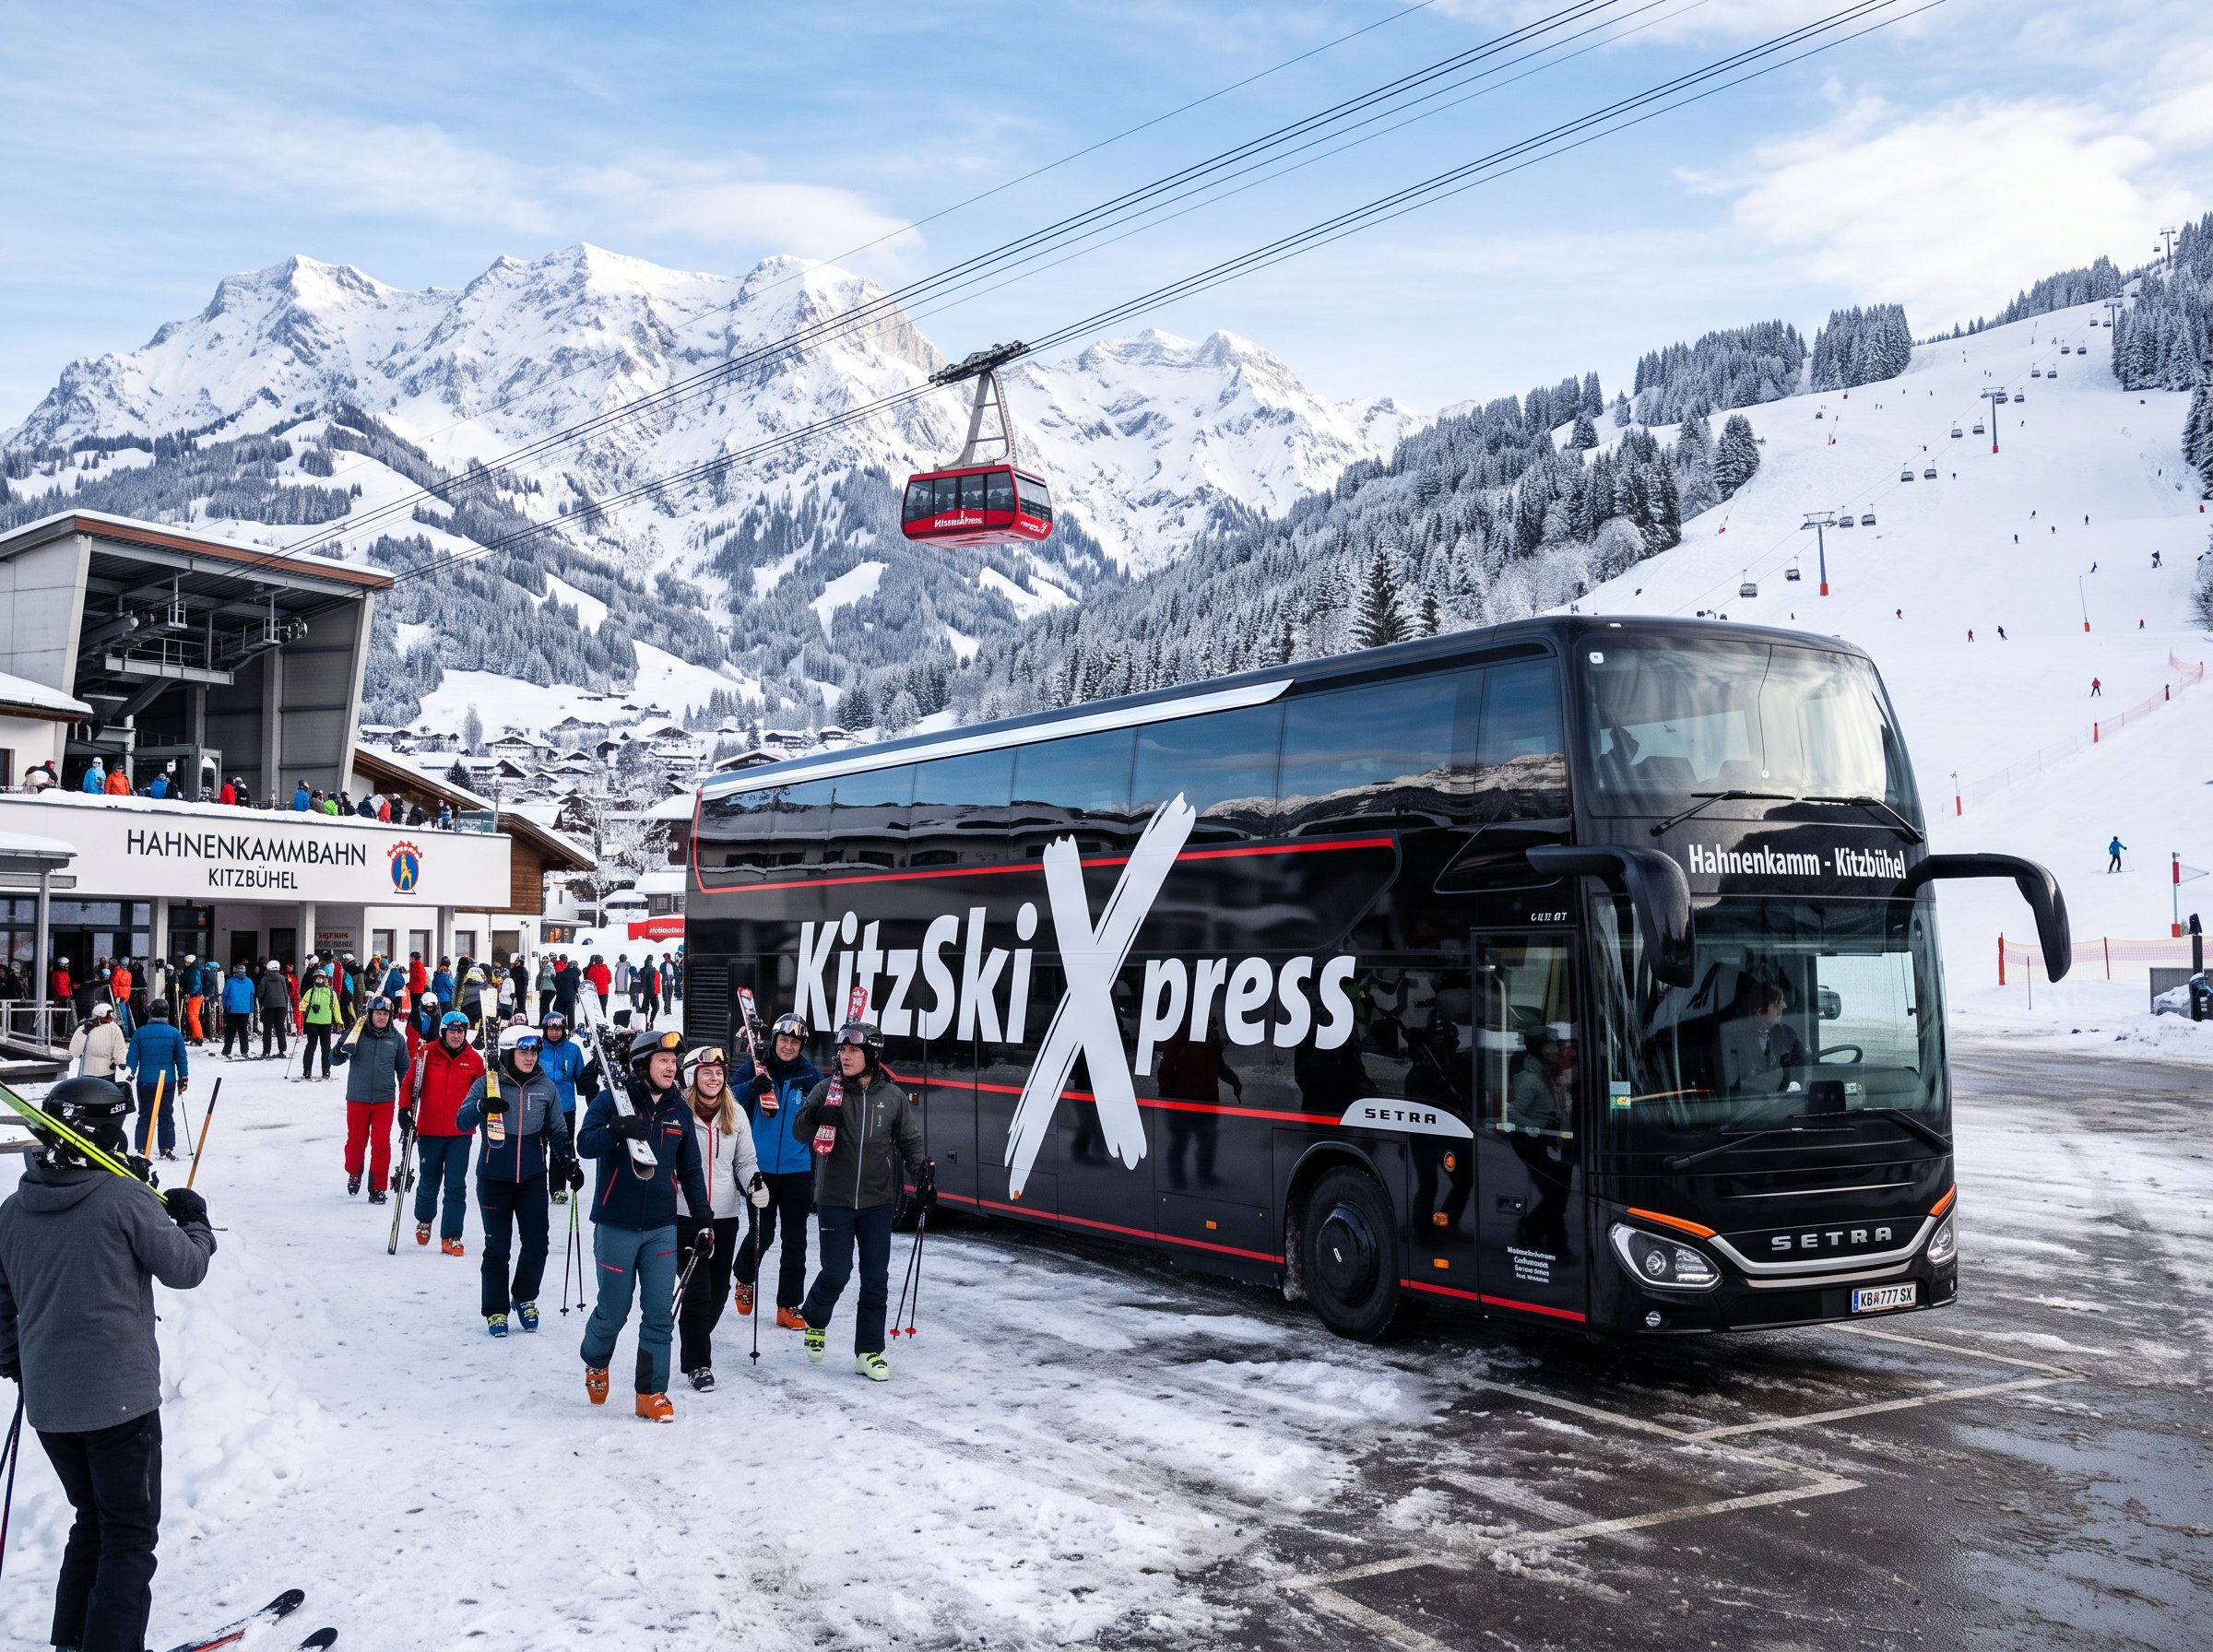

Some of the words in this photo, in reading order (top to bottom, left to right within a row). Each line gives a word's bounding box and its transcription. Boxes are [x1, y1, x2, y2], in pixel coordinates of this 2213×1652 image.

[126, 829, 366, 867] HAHNENKAMMBAHN
[1688, 844, 1820, 876] Hahnenkamm
[1834, 847, 1907, 879] Kitzbühel
[208, 867, 298, 890] KITZBÜHEL
[1365, 1108, 1437, 1124] SETRA
[1771, 1227, 1892, 1251] SETRA
[1881, 1289, 1899, 1304] 777
[1899, 1287, 1912, 1303] SX
